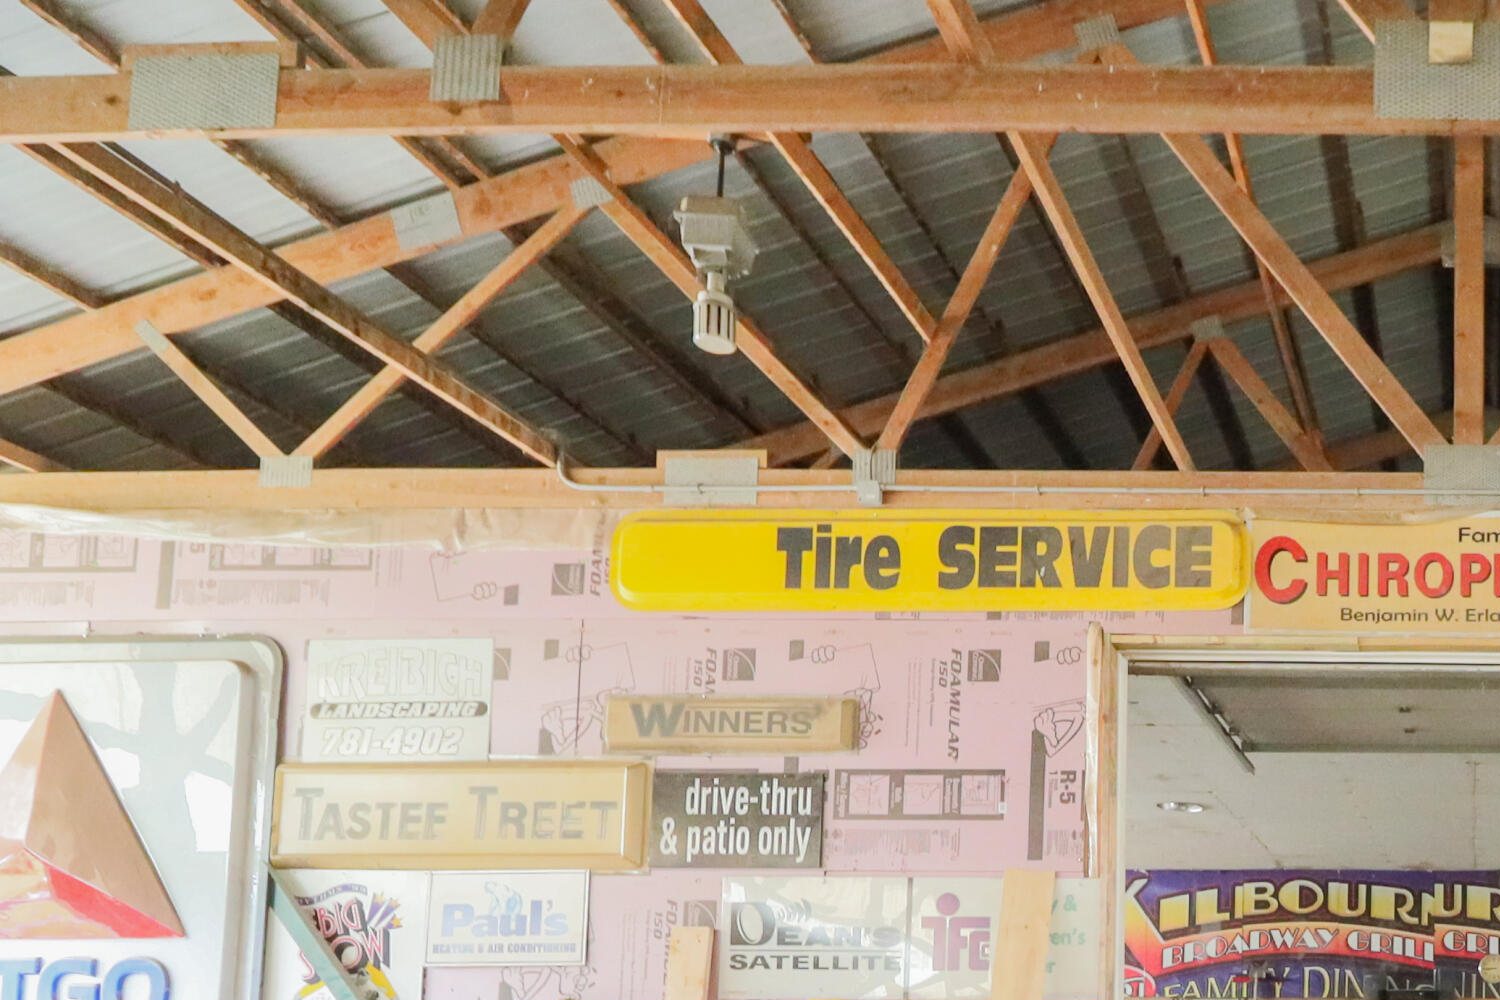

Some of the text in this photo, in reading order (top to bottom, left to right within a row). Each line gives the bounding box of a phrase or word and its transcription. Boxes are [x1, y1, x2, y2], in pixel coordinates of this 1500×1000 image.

[777, 525, 1213, 590] Tire SERVICE
[1340, 607, 1429, 624] Benjamin
[1435, 608, 1459, 622] W.
[317, 702, 479, 718] LANDSCAPING
[320, 727, 464, 756] 781-4902
[468, 786, 618, 841] TREET
[685, 777, 812, 816] drive-thru
[659, 816, 678, 855] &
[686, 817, 750, 863] patio
[758, 818, 811, 863] only
[441, 898, 569, 937] Paul's
[729, 954, 902, 971] SATELLITE
[1162, 928, 1339, 969] BROADWAY
